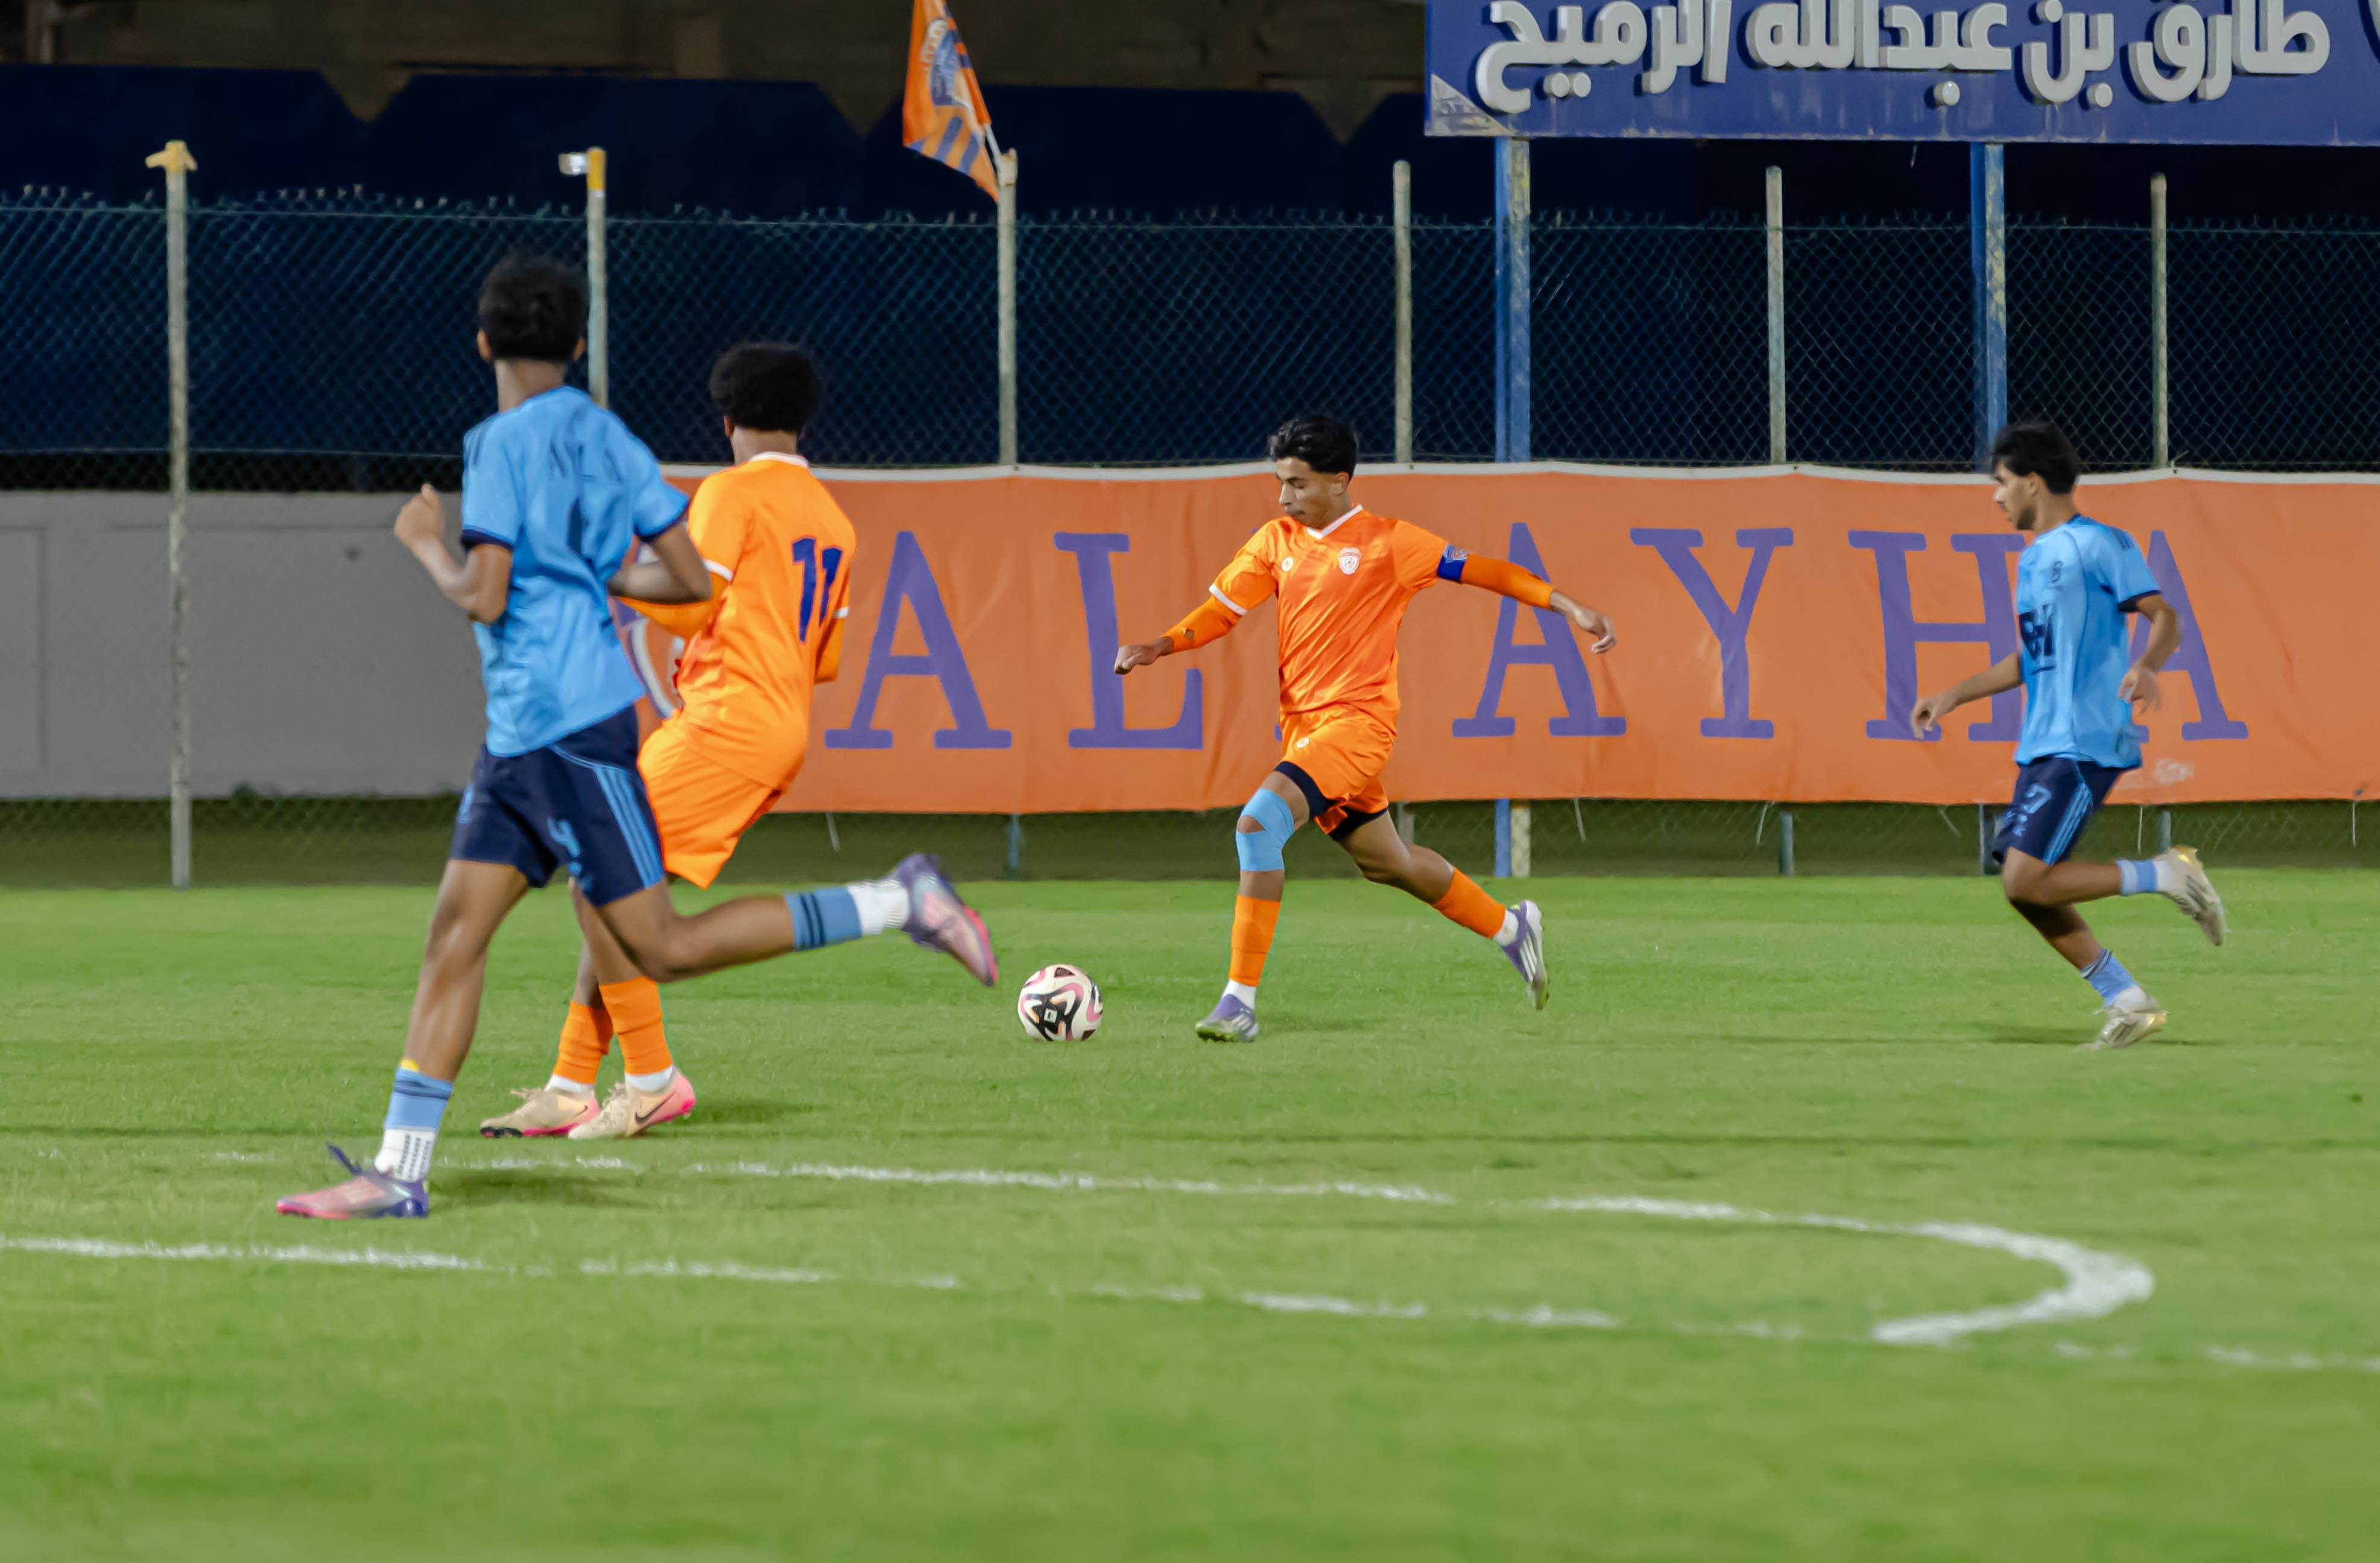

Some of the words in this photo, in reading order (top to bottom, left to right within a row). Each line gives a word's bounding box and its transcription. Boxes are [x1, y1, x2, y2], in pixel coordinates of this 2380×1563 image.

[1745, 0, 2012, 106] عبدالله
[2022, 0, 2114, 108] بن
[2128, 0, 2331, 102] طارق
[791, 536, 843, 643] 11
[824, 531, 1204, 750] AL
[1252, 522, 2249, 742] AYHA
